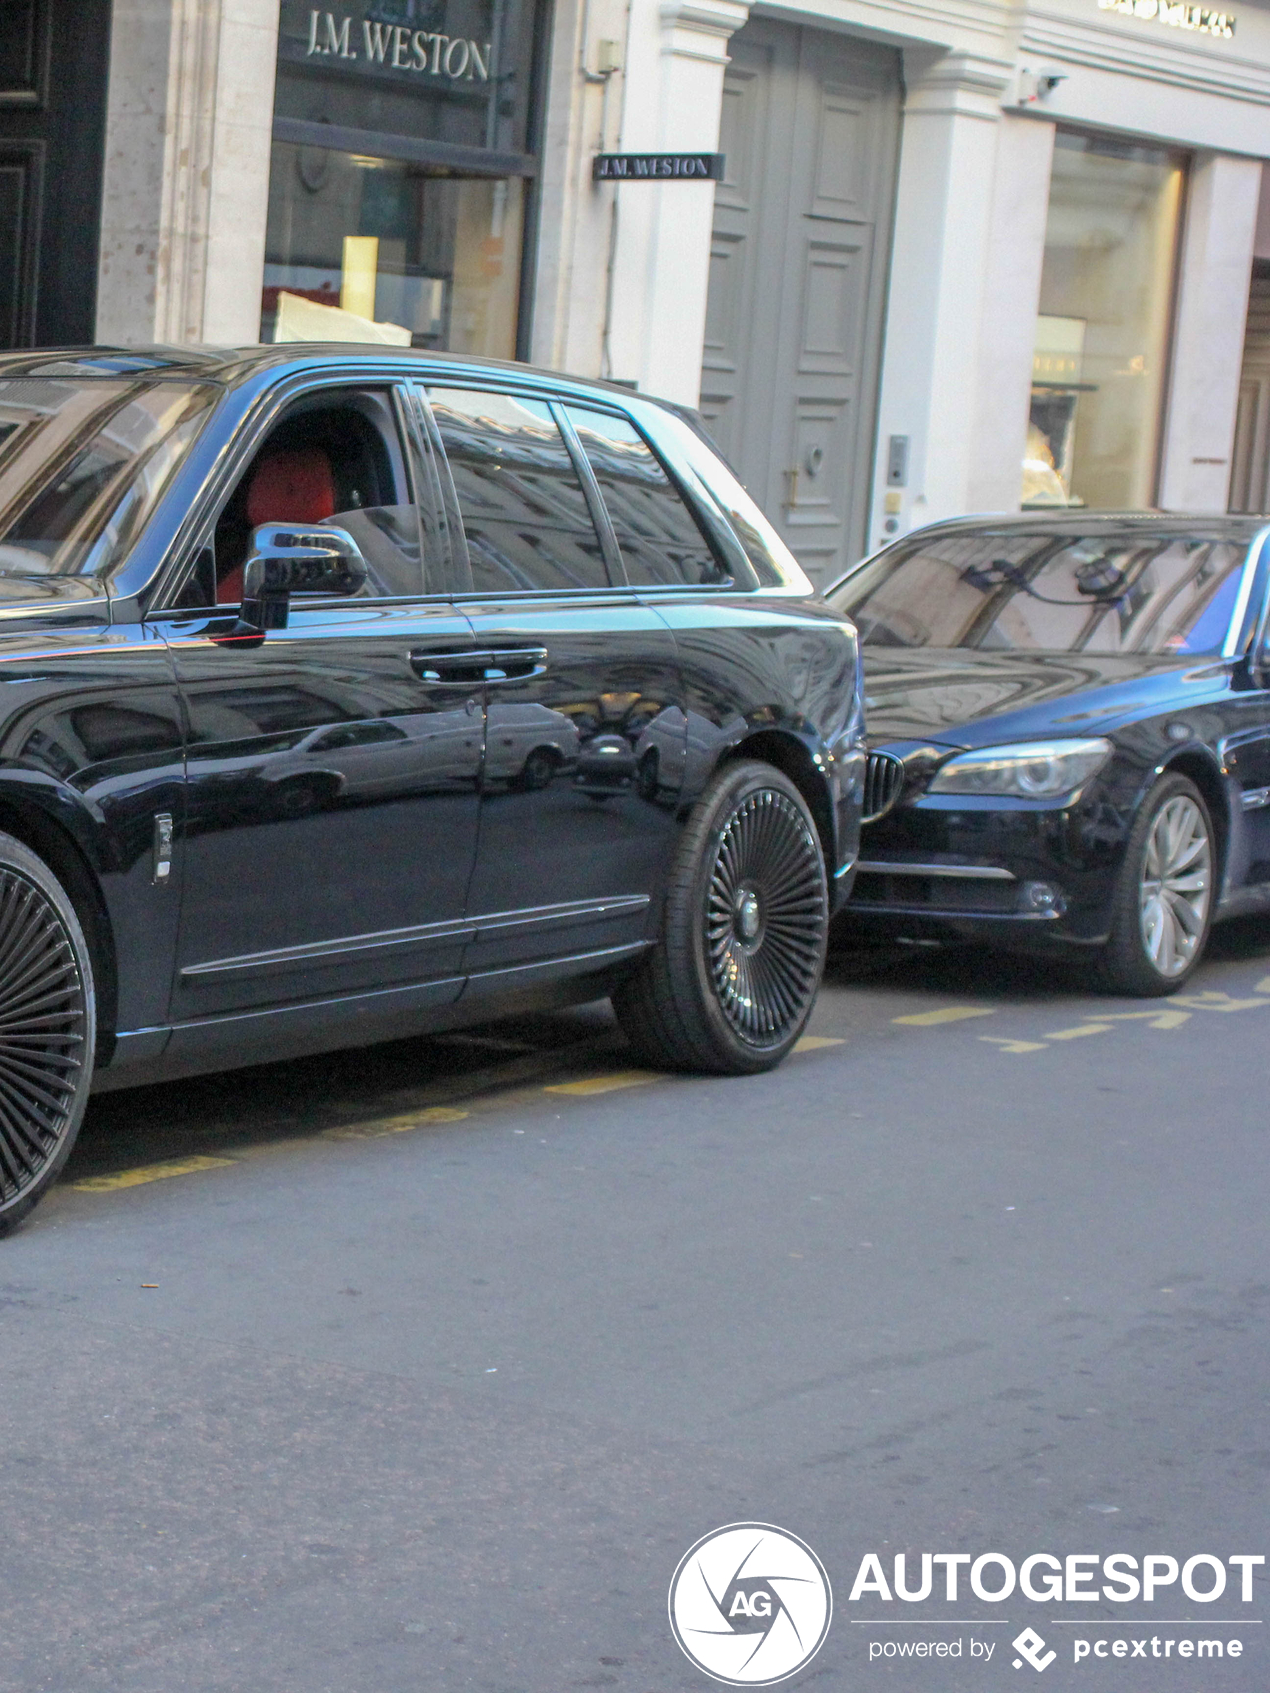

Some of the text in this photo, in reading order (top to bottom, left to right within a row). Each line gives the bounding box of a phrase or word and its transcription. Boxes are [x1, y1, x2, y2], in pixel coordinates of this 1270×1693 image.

[307, 10, 492, 82] J.M. WESTON
[600, 157, 708, 176] J.M. WESTON
